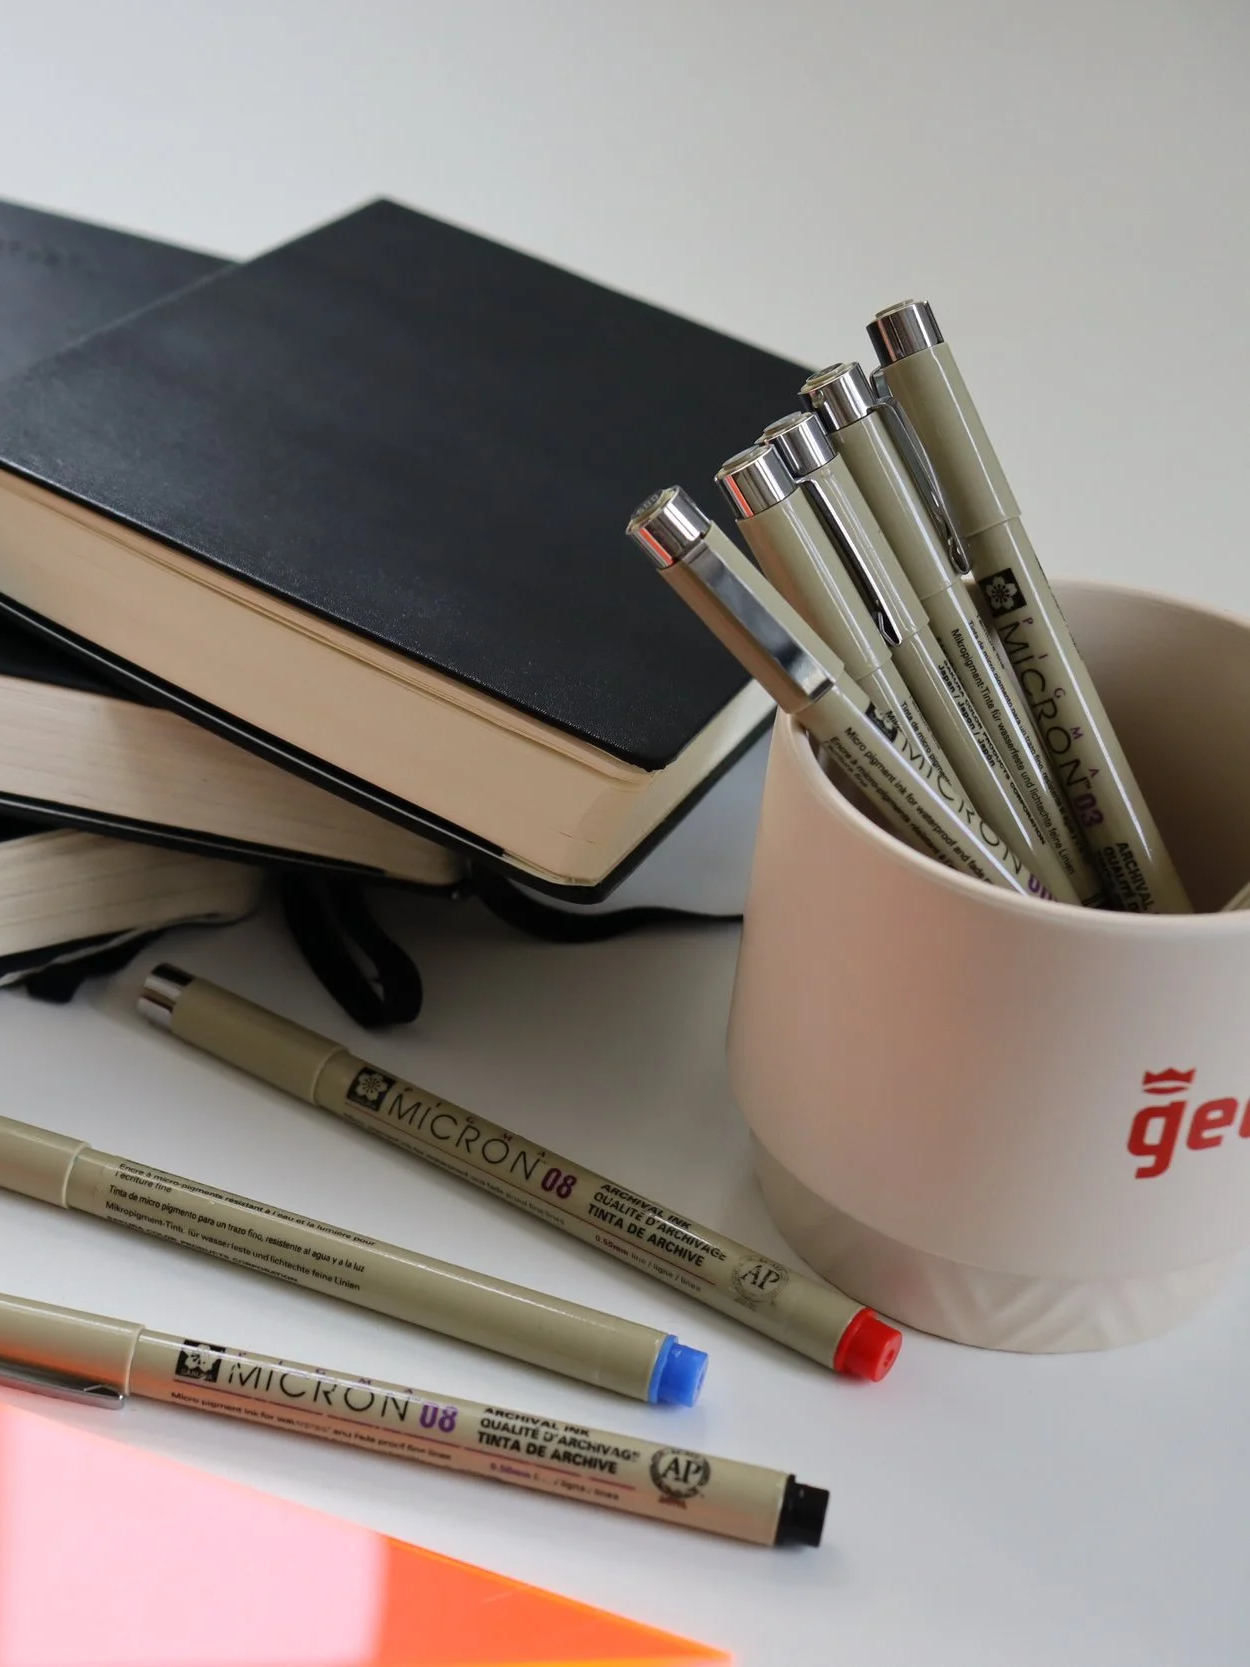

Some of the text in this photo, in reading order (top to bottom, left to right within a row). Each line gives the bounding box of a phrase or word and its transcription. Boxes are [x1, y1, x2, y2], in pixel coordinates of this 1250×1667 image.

[949, 627, 997, 710] Mikropigment-Tinte
[967, 620, 980, 639] Tinta
[977, 639, 986, 650] de
[982, 649, 996, 672] micro
[1023, 735, 1036, 755] trazo
[898, 701, 915, 722] Tinta
[909, 720, 920, 732] de
[915, 730, 933, 753] micro
[935, 662, 957, 694] Japan
[956, 699, 977, 730] Japon
[975, 736, 997, 767] Japón
[989, 707, 1003, 722] für
[997, 619, 1086, 790] MICRON
[1071, 790, 1105, 831] 03
[941, 659, 966, 697] SAKURA
[963, 698, 983, 729] COLOR
[981, 730, 1011, 780] PRODUCTS
[1008, 780, 1046, 844] CORPORATION
[995, 720, 1027, 772] wasserfeste
[843, 724, 870, 753] Micro
[861, 747, 898, 786] pigment
[892, 778, 910, 796] ink
[904, 791, 920, 808] for
[913, 802, 958, 850] waterproof
[951, 843, 971, 864] and
[1019, 770, 1035, 789] und
[1027, 787, 1055, 829] lichtechte
[1047, 826, 1065, 849] feine
[1057, 847, 1077, 875] Linien
[1115, 838, 1155, 911] ARCHIVAL
[387, 1088, 539, 1184] MICRON
[538, 1164, 579, 1202] 08
[1127, 1097, 1250, 1180] ge
[119, 1162, 145, 1176] Encre
[152, 1172, 223, 1201] micro-pigments
[352, 1235, 375, 1247] pour
[154, 1181, 173, 1194] fine
[600, 1180, 692, 1231] ARCHIVAL INK
[107, 1184, 365, 1273] Tinta de micro pigmento para un trazo fino, resistente al agua y a la luz
[585, 1201, 705, 1269] TINTA DE ARCHIVE
[251, 1249, 269, 1261] und
[269, 1255, 311, 1275] lichtechte
[310, 1268, 333, 1282] feine
[738, 1257, 782, 1295] AP
[171, 1390, 200, 1403] Micro
[201, 1397, 242, 1414] pigment
[244, 1407, 259, 1416] ink
[259, 1410, 274, 1420] for
[227, 1357, 459, 1434] MICRON 08
[483, 1406, 590, 1437] ARCHIVAL INK
[475, 1430, 619, 1475] TINTA DE ARCHIVE
[660, 1453, 704, 1486] AP
